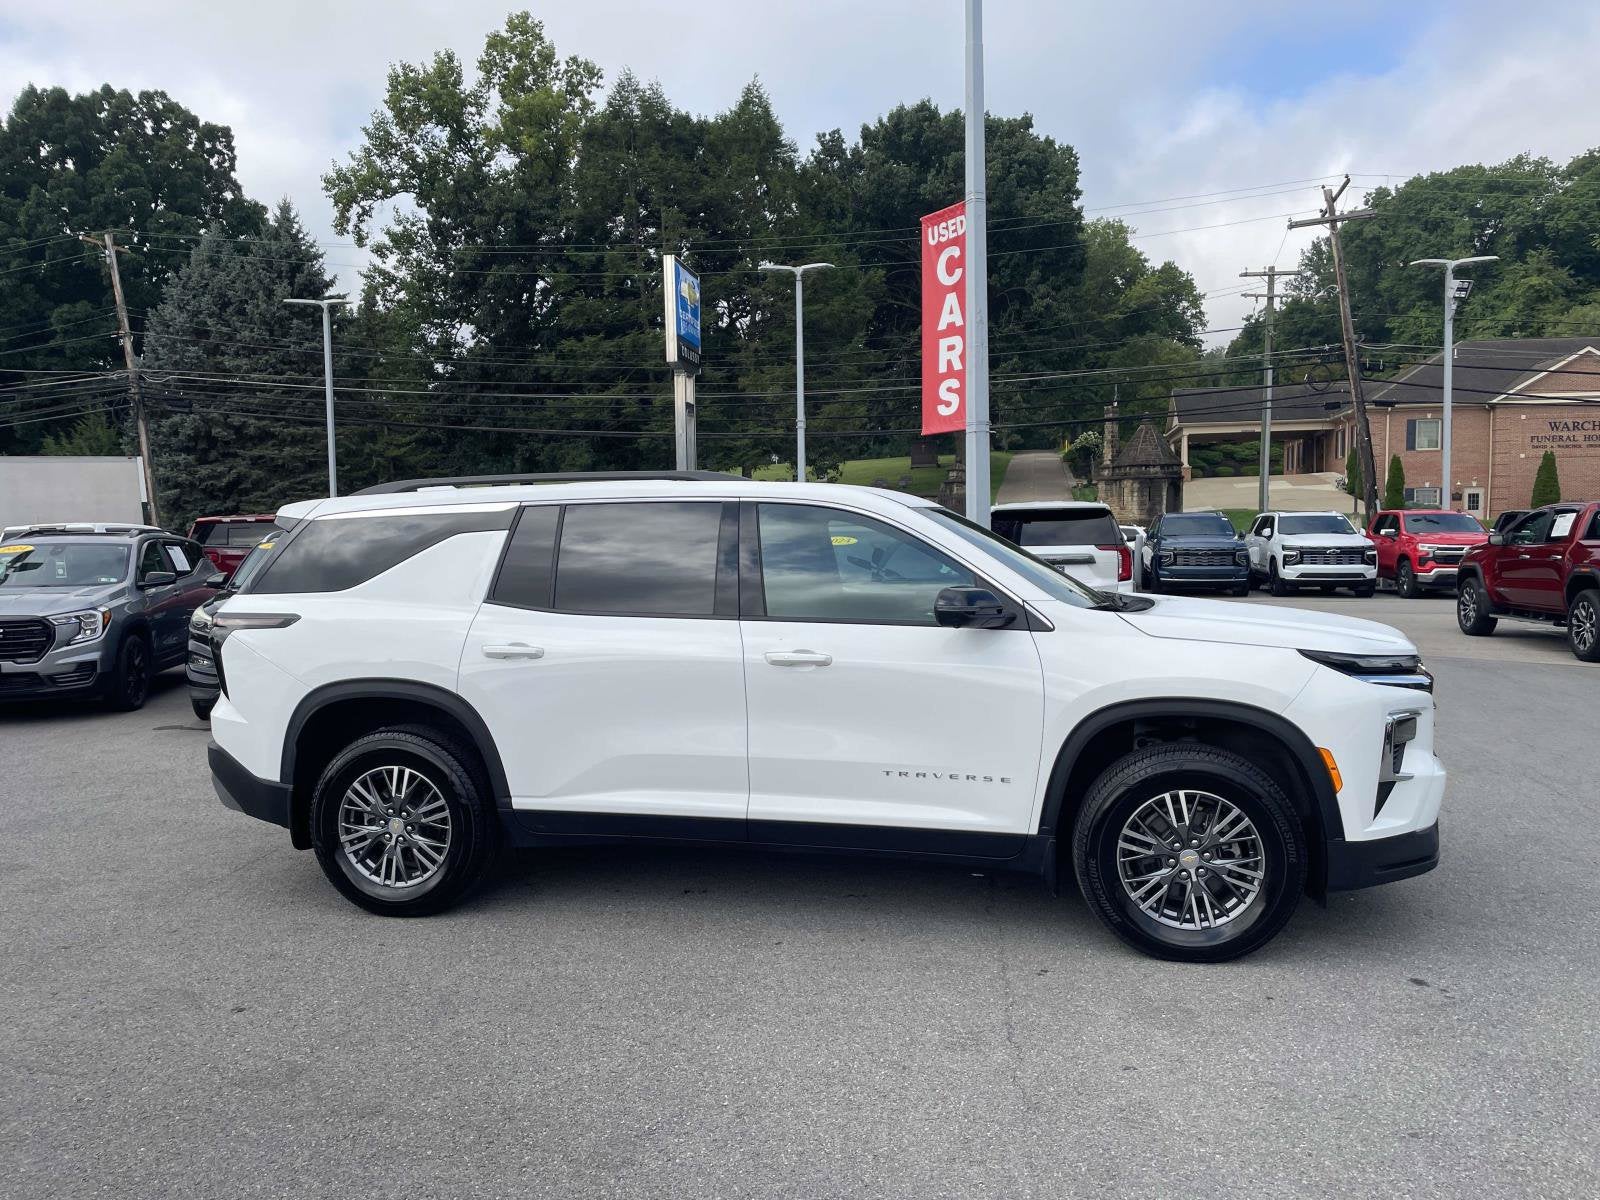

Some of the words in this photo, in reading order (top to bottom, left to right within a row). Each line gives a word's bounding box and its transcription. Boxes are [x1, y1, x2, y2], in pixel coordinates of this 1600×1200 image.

[928, 215, 966, 246] USED
[936, 245, 964, 416] CARS
[1530, 434, 1579, 443] FUNERAL
[881, 770, 1012, 784] TRAVERSE
